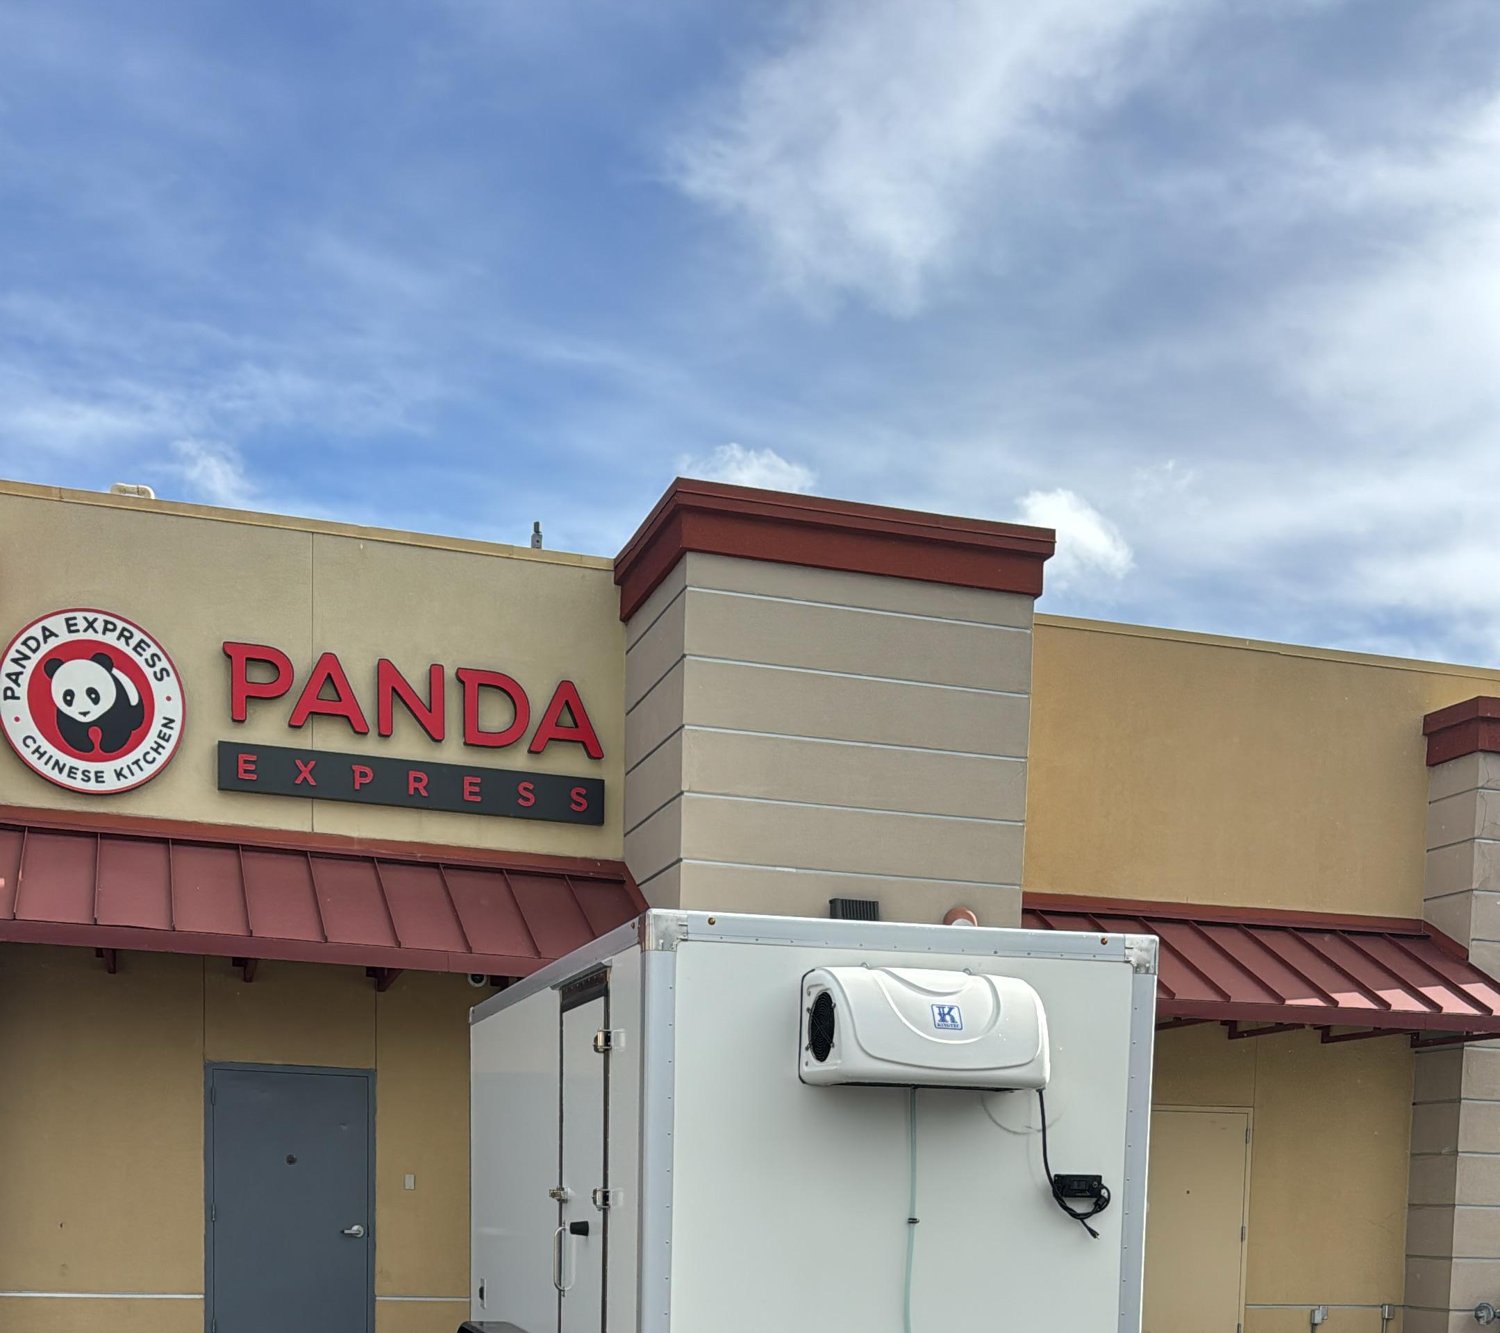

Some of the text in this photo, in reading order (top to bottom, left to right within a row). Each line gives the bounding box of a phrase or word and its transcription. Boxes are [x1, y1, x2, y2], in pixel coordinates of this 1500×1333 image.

[3, 615, 171, 702] PANDA EXPRESS
[222, 640, 605, 761] PANDA
[22, 715, 177, 784] CHINESE KITCHEN
[237, 752, 589, 813] EXPRESS
